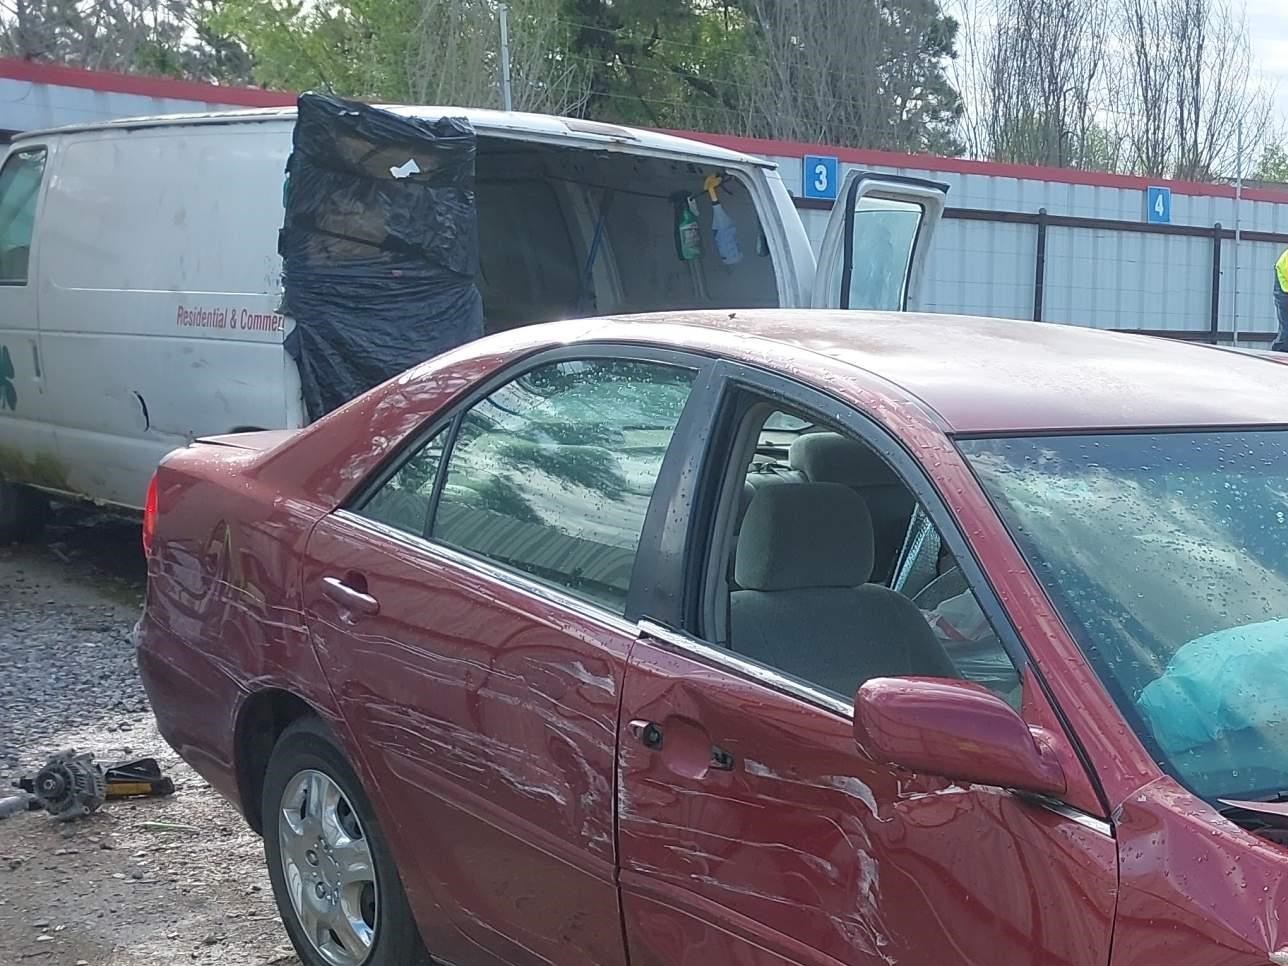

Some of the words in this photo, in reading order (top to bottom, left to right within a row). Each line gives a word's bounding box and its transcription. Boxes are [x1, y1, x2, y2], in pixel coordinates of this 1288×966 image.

[814, 164, 828, 192] 3
[1154, 194, 1164, 217] 4
[176, 305, 228, 329] Residential
[229, 308, 238, 330] &
